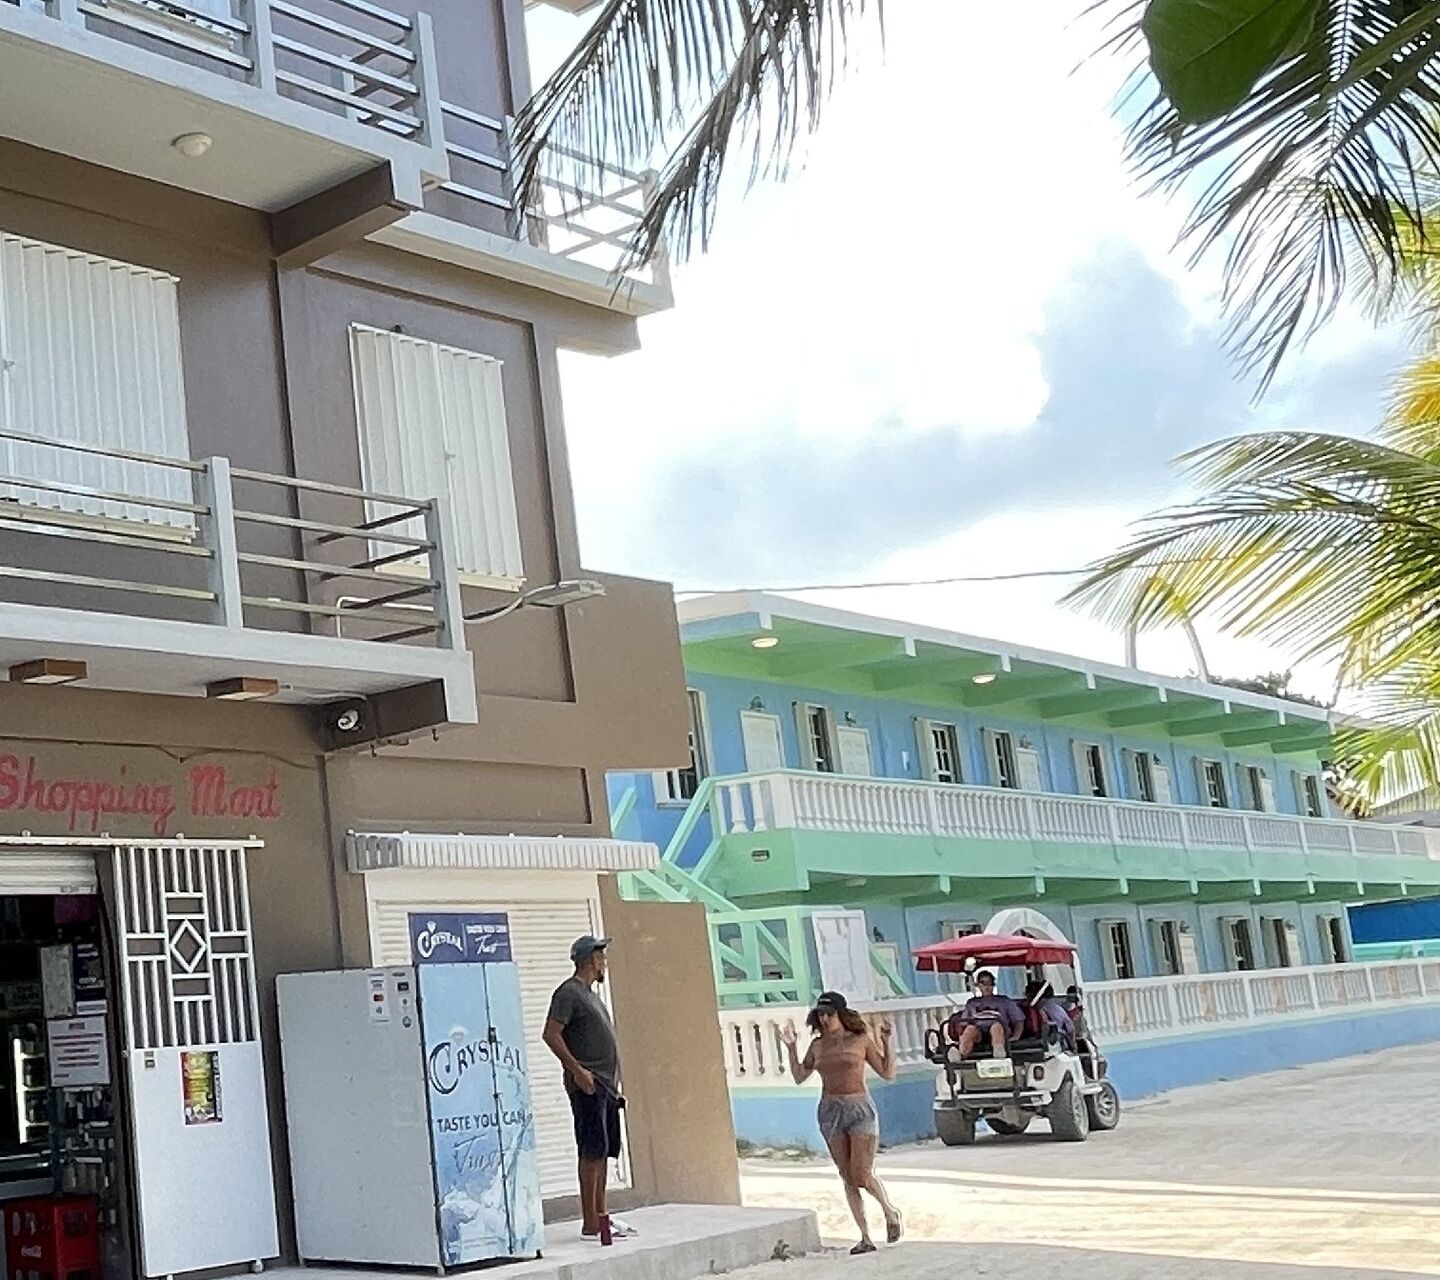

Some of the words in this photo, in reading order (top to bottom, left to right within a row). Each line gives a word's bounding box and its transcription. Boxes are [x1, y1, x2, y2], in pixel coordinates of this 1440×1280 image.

[189, 764, 284, 818] Mart
[437, 1114, 471, 1133] TASTE
[472, 1112, 499, 1129] YOU
[502, 1109, 526, 1127] CAN
